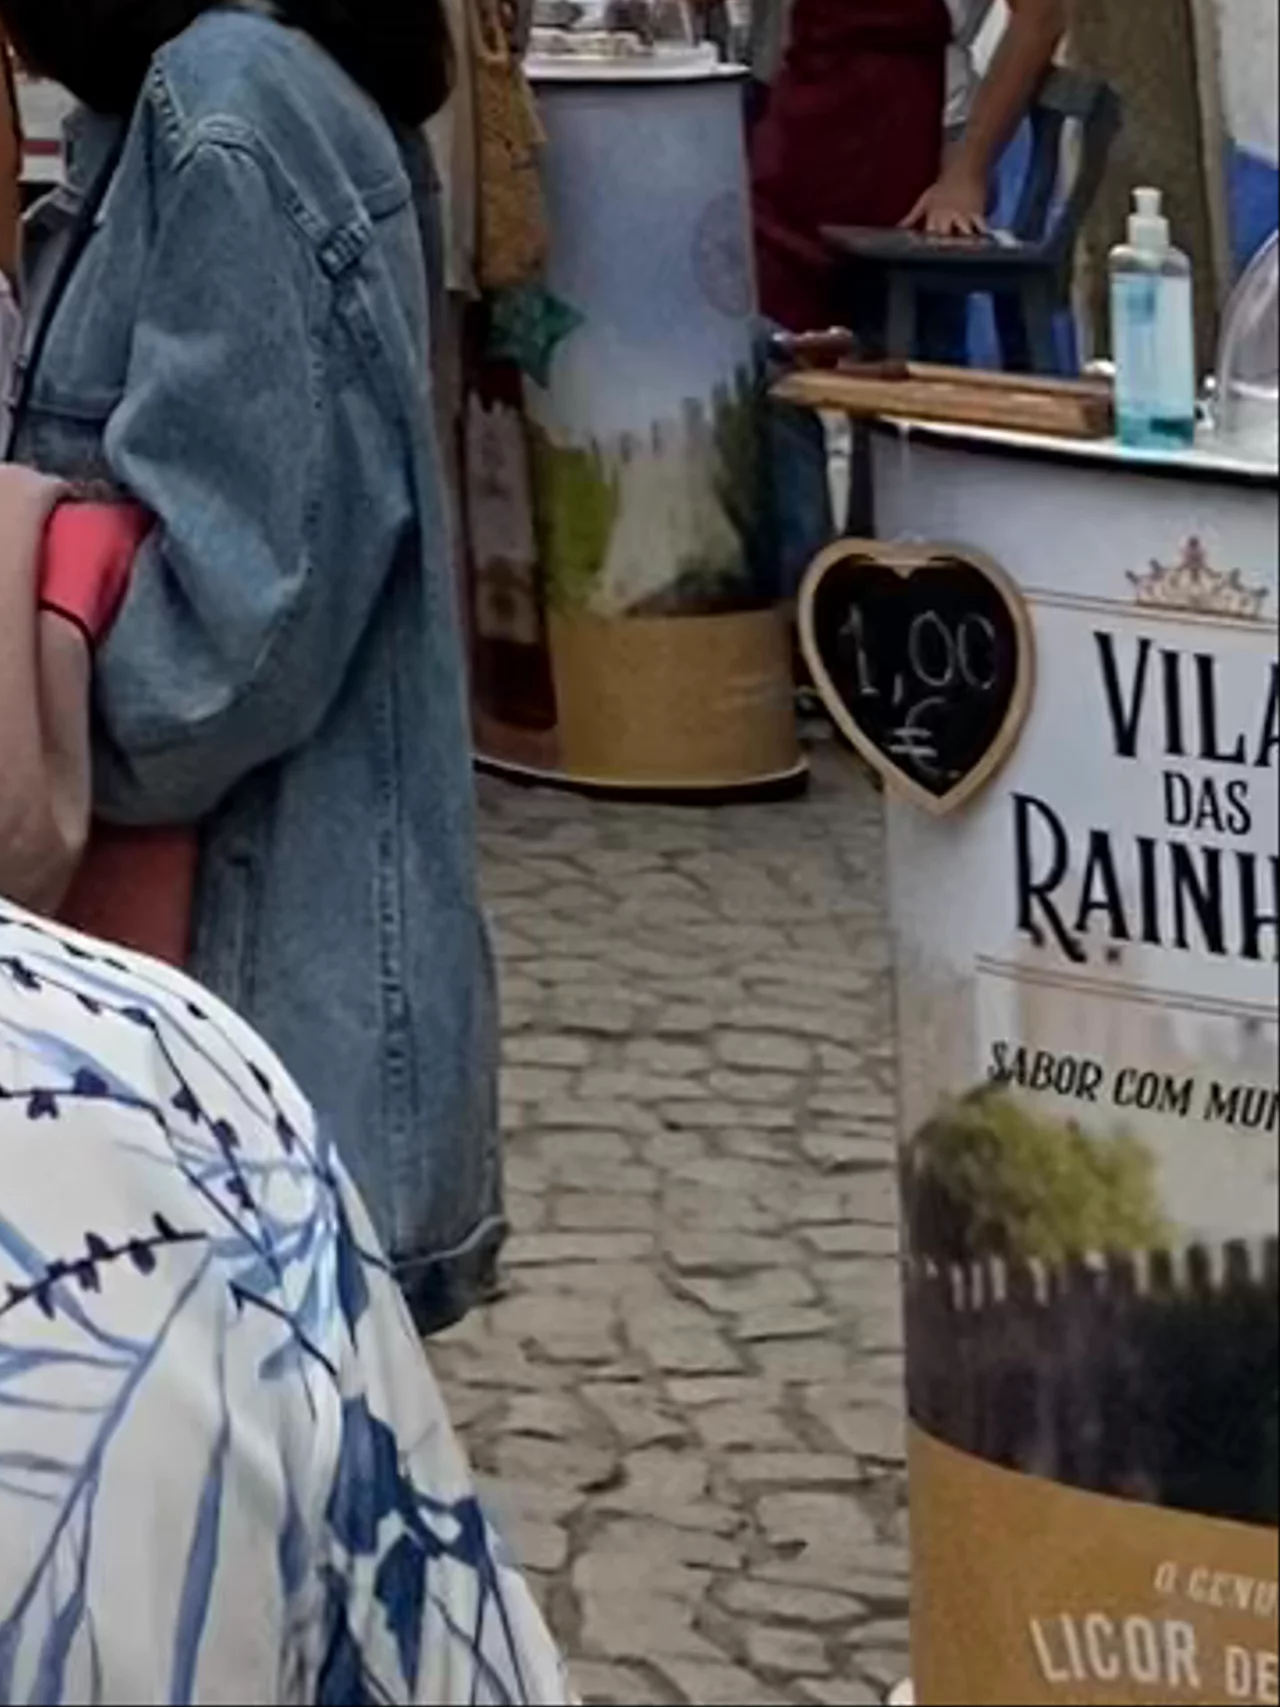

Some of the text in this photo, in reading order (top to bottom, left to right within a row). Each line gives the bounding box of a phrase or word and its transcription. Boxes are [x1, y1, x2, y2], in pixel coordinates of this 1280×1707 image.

[838, 602, 996, 706] 1,00
[888, 694, 962, 778] €
[1163, 770, 1252, 836] DAS
[989, 1040, 1103, 1102] SABOR
[1113, 1067, 1194, 1118] COM
[1030, 1612, 1280, 1705] LICOR DE
